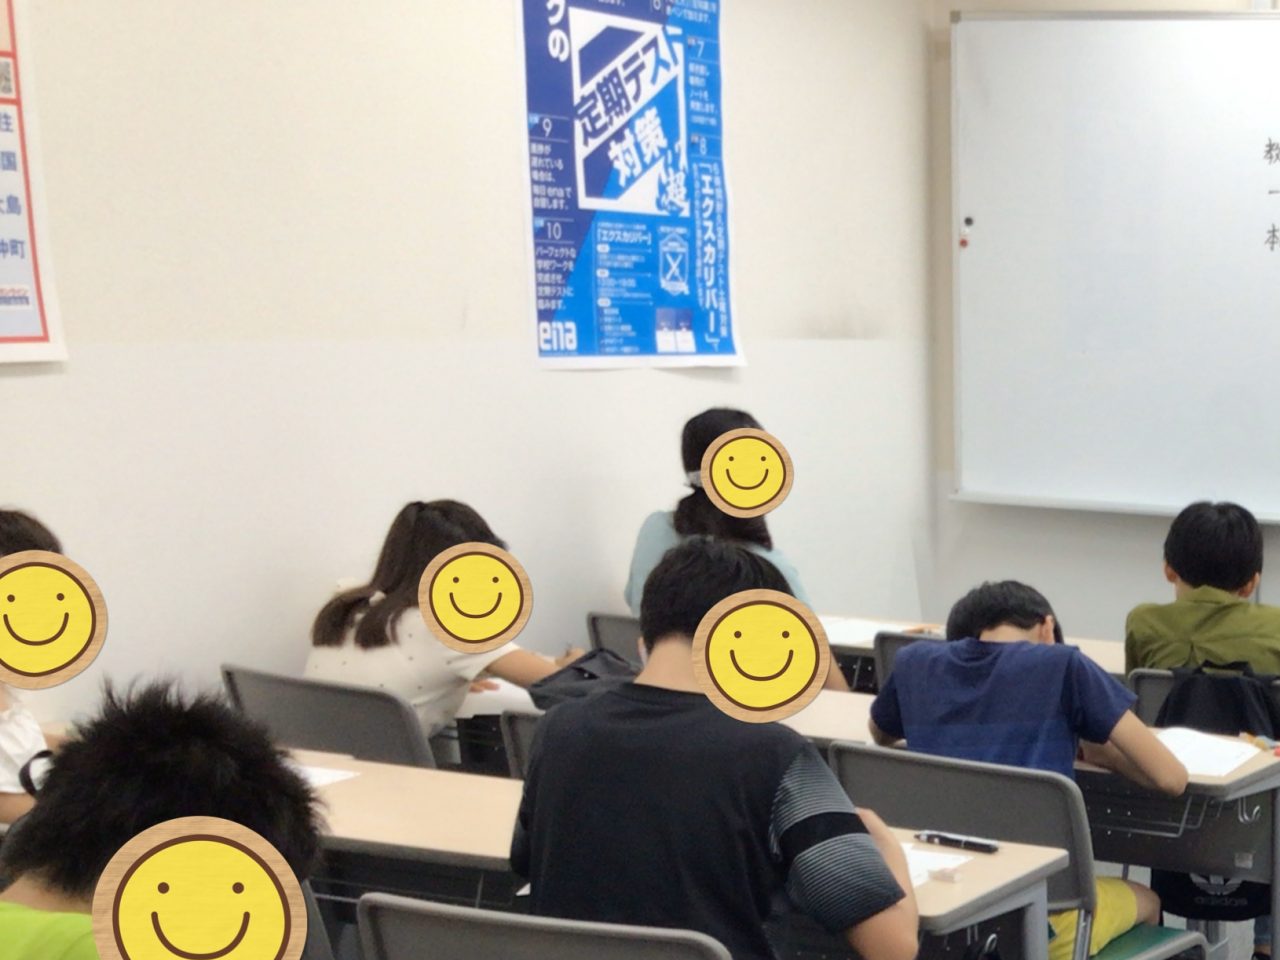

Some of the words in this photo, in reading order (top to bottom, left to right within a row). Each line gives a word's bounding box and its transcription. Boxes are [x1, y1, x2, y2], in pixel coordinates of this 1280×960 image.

[574, 26, 683, 147] 定期テスト
[542, 117, 553, 138] 9
[608, 106, 667, 188] 対策
[546, 221, 562, 241] 10
[539, 321, 578, 352] ena
